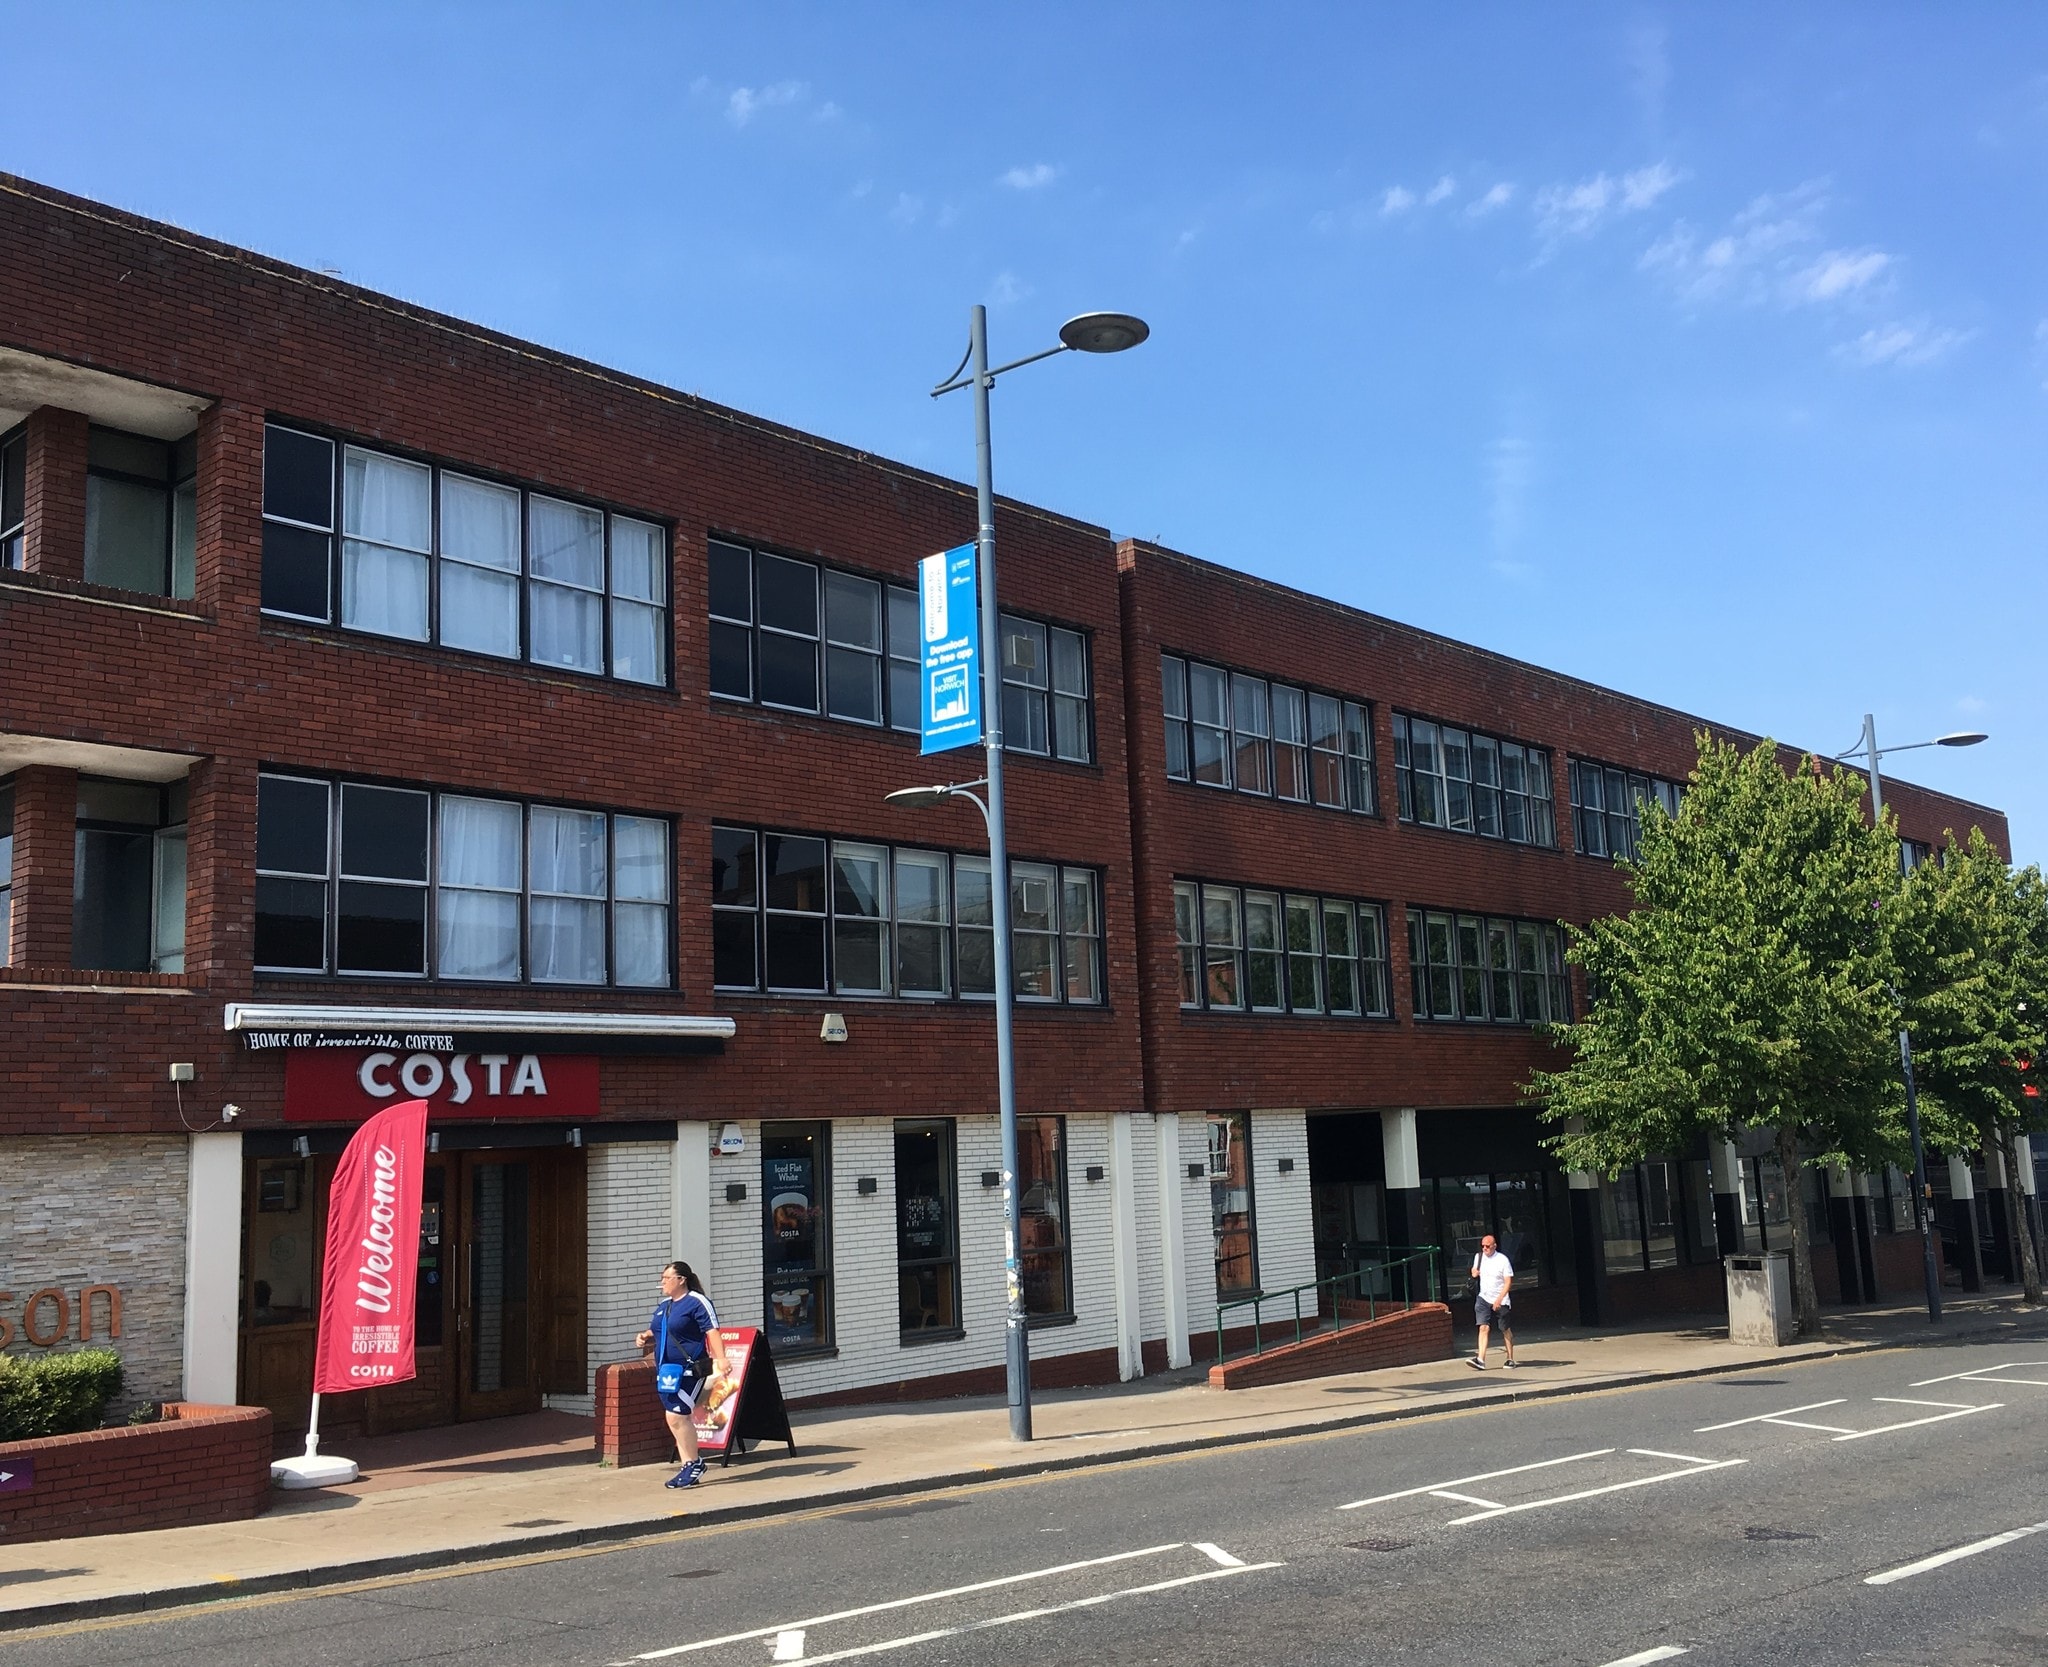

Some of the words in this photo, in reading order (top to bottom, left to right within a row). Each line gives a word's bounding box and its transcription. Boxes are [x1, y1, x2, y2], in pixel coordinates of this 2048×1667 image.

[930, 636, 969, 656] Download
[939, 653, 956, 664] free
[956, 648, 974, 660] app
[943, 674, 957, 684] VISIT
[935, 680, 965, 693] NORWICH
[248, 1033, 290, 1050] HOME
[293, 1033, 312, 1048] OF
[405, 1035, 454, 1051] COFFEE
[358, 1052, 549, 1104] COSTA
[774, 1164, 788, 1173] Iced
[789, 1163, 803, 1172] Flat
[778, 1173, 799, 1181] White
[355, 1144, 396, 1314] Welcome
[780, 1230, 800, 1238] COSTA
[361, 1325, 375, 1333] THE
[352, 1332, 400, 1340] IRRESISTIBLE
[721, 1332, 740, 1341] COSTA
[782, 1334, 801, 1343] COSTA
[351, 1340, 400, 1354] COFFEE
[350, 1365, 394, 1378] COSTA
[696, 1430, 714, 1439] OSTA
